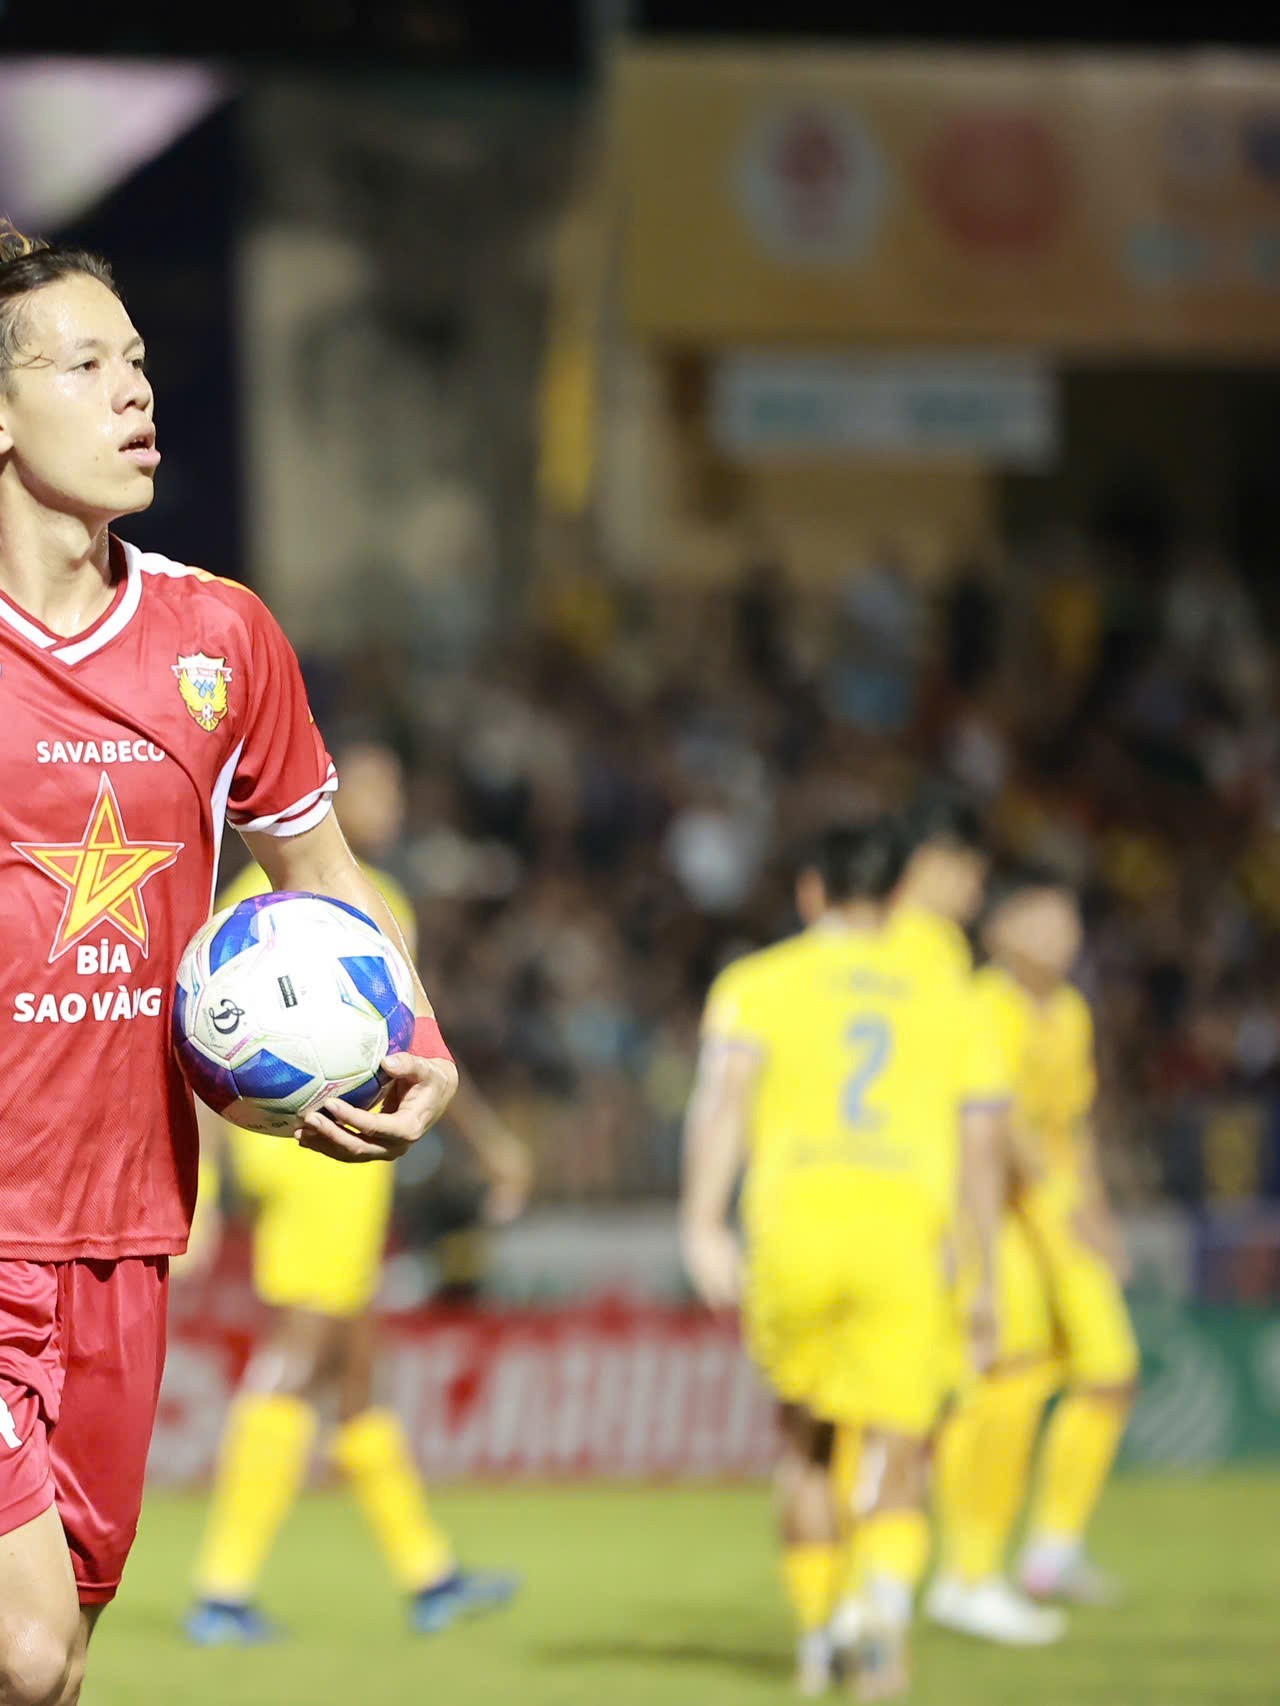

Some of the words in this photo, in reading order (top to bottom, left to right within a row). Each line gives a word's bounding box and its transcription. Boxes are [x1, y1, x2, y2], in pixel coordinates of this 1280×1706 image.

[36, 739, 166, 764] SAVABECO
[13, 992, 87, 1024] SAO
[841, 1012, 892, 1131] 2
